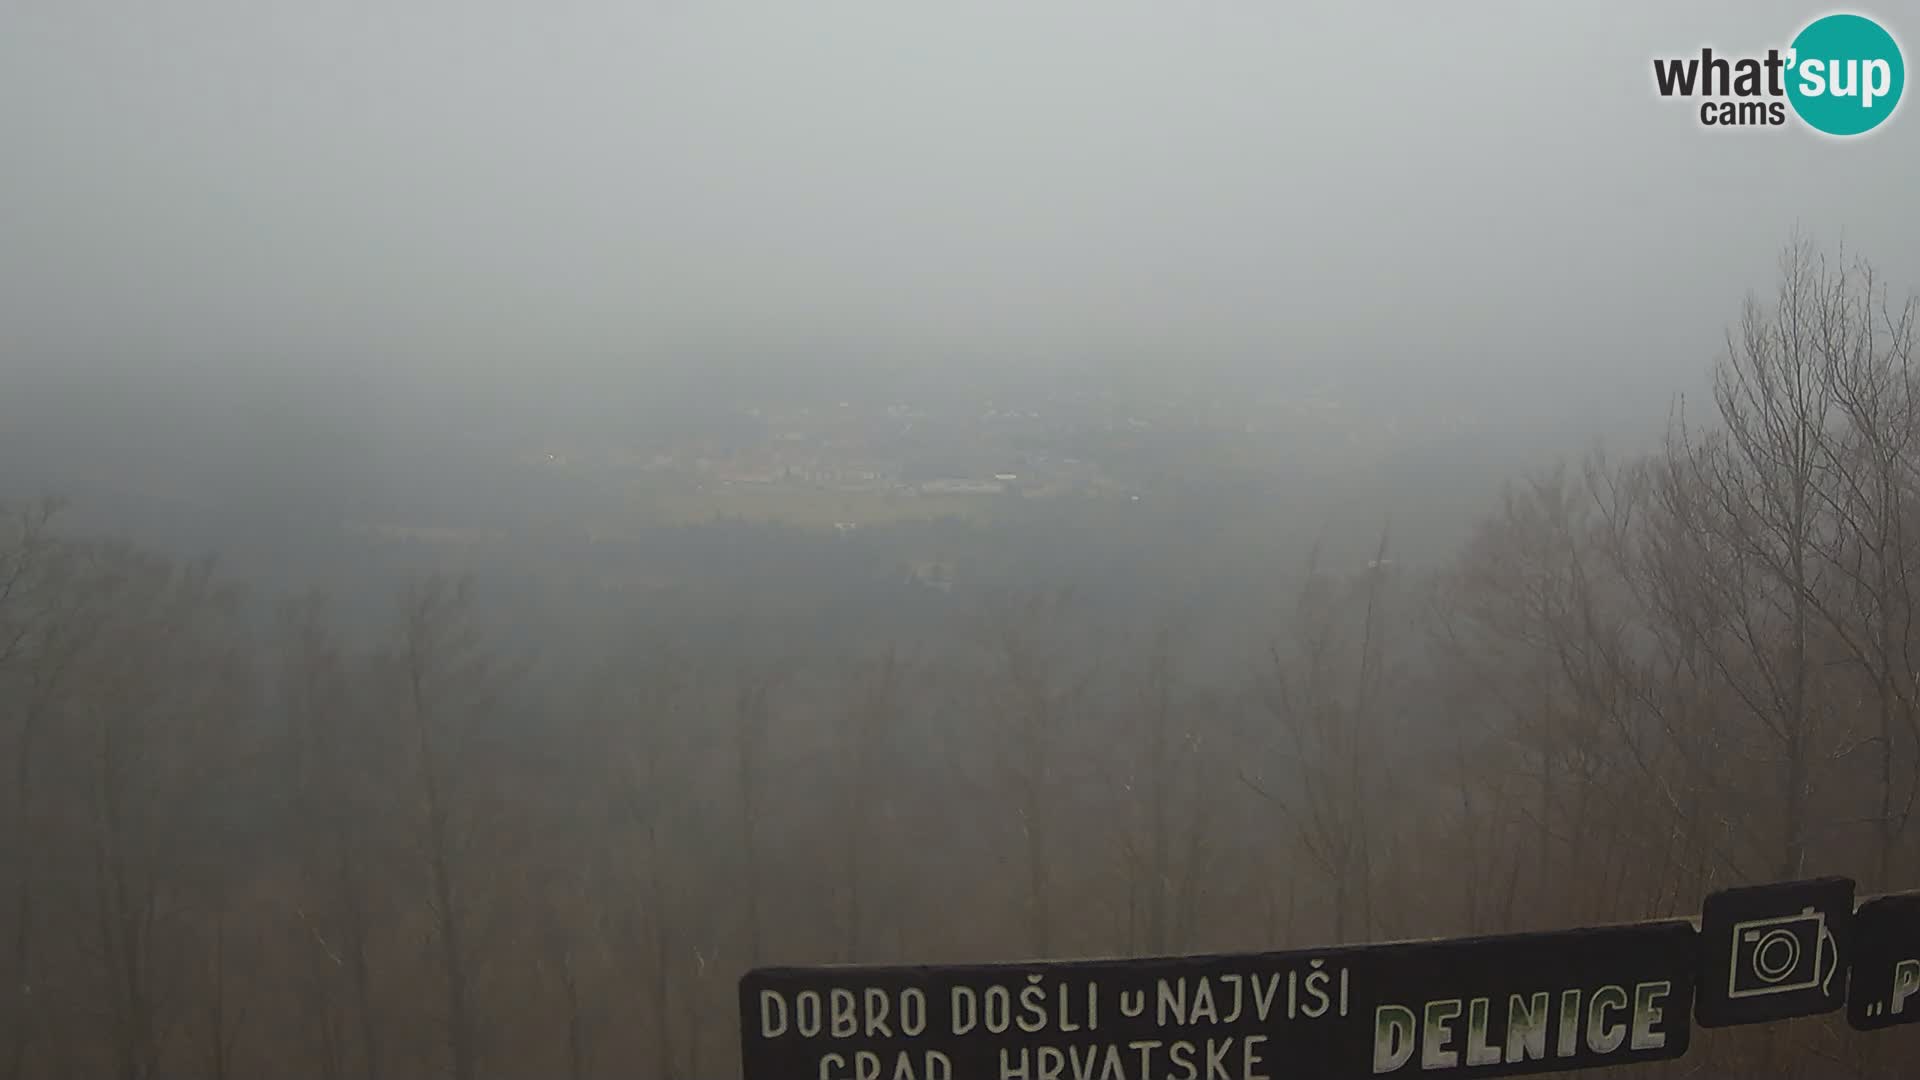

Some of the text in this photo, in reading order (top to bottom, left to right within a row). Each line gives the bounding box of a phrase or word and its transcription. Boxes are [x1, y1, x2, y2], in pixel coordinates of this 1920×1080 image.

[760, 988, 927, 1039] DOBRO
[951, 975, 1099, 1036] DOŠLI
[1156, 959, 1350, 1026] NAJVIŠI
[1373, 981, 1671, 1074] DELNICE
[1000, 1035, 1268, 1080] HRVATSKE
